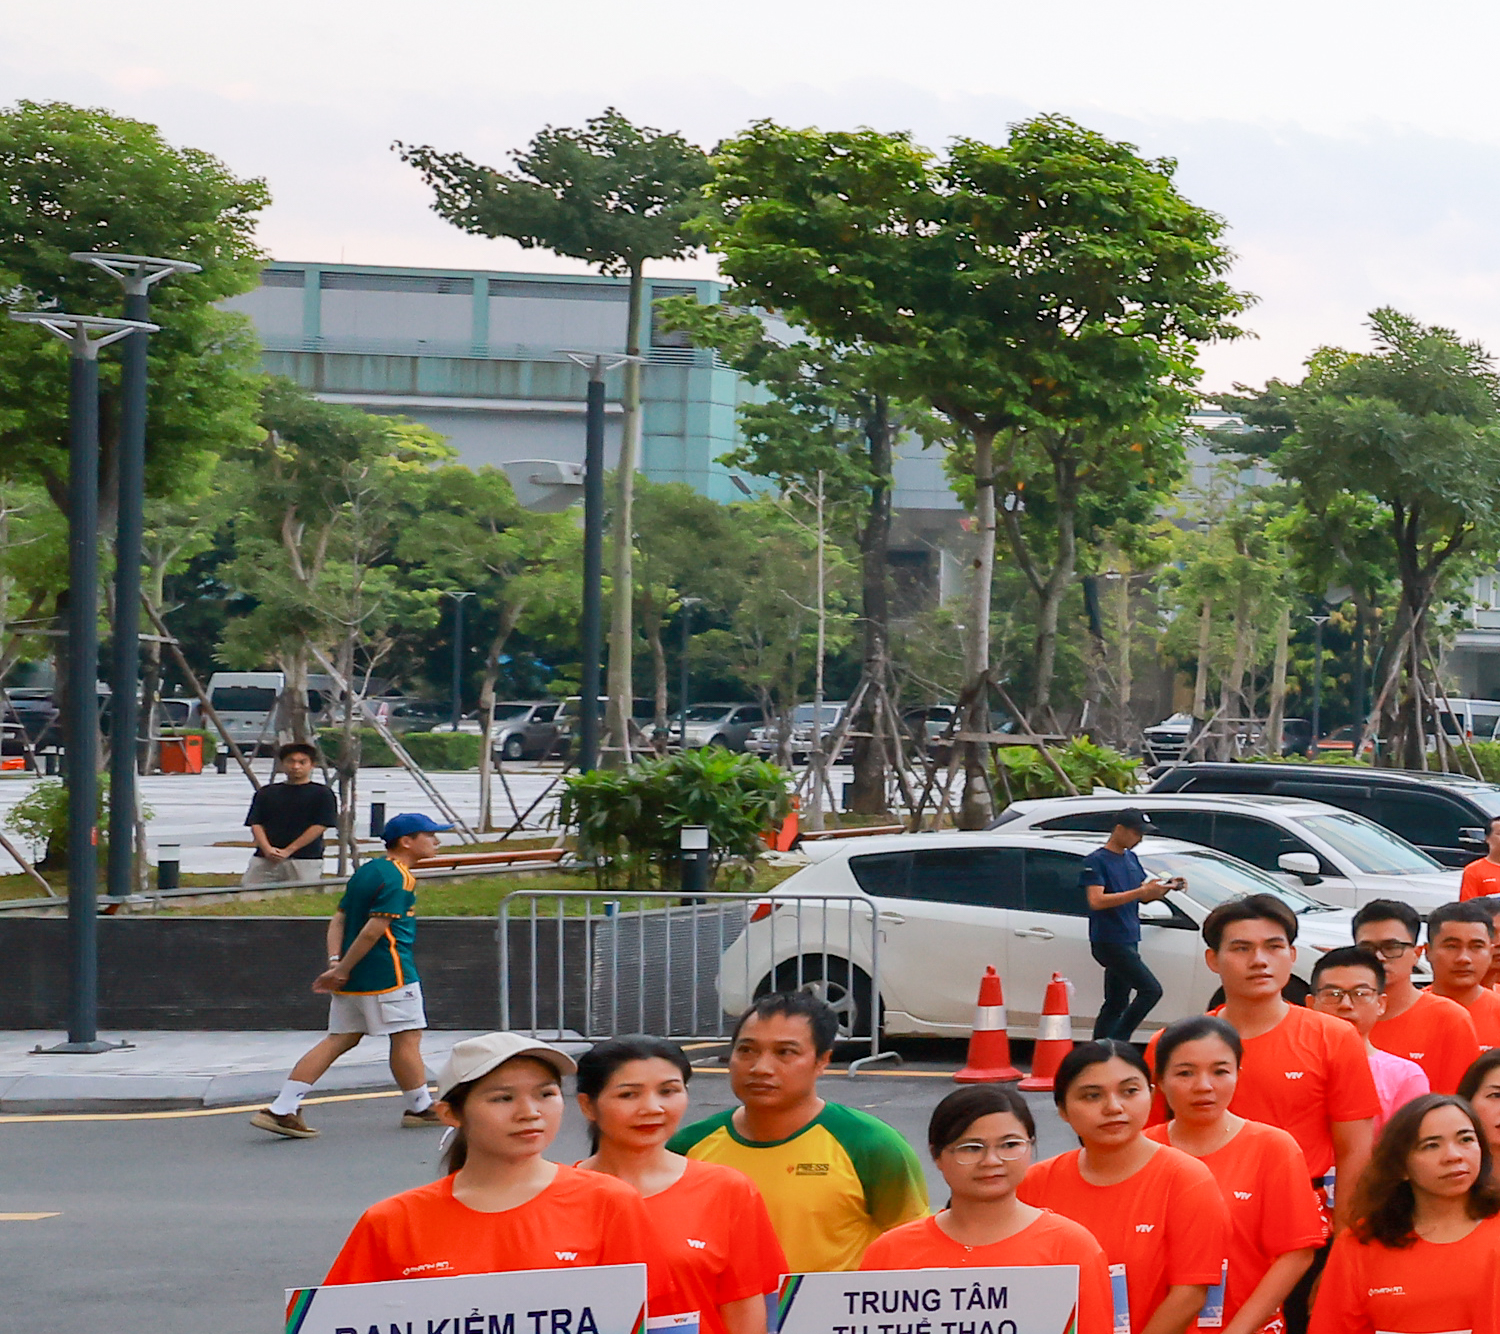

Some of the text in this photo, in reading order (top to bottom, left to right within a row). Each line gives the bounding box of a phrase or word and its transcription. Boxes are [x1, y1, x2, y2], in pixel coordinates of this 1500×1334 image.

[554, 1251, 578, 1261] VTV
[844, 1282, 1008, 1314] TRUNG TÂM
